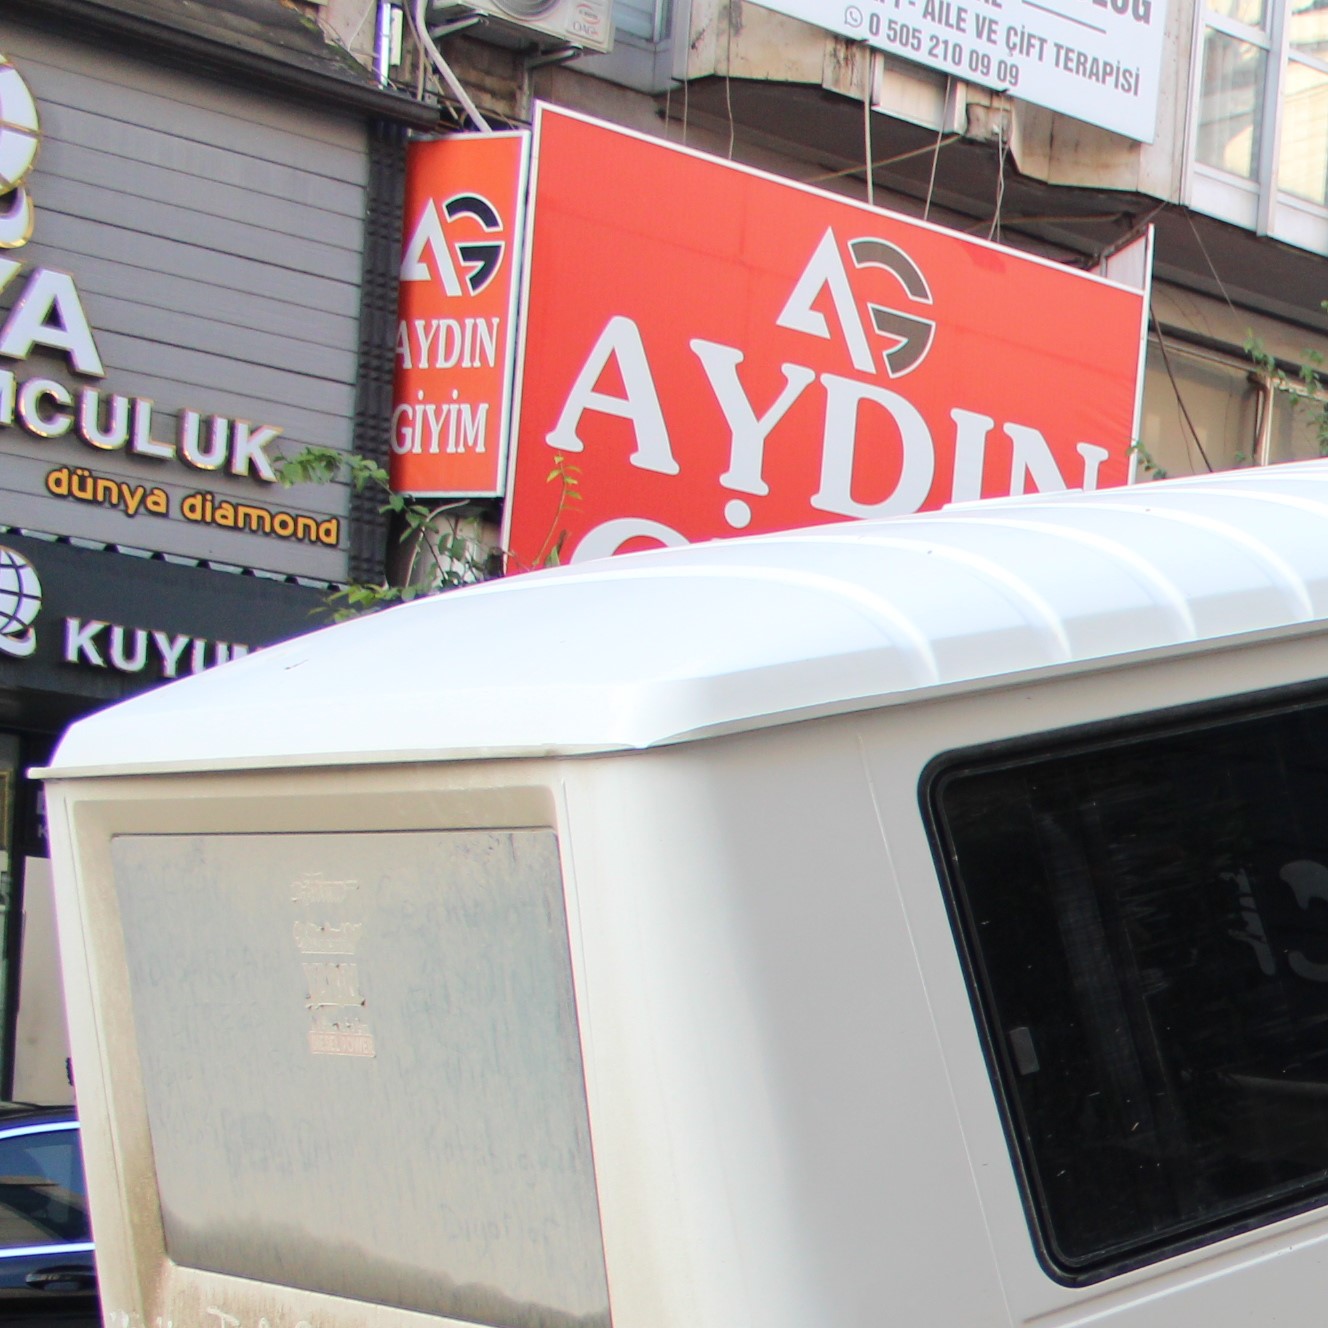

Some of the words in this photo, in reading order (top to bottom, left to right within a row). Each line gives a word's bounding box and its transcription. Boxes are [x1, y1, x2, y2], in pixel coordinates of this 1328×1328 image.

[868, 13, 881, 36] 0
[886, 20, 922, 51] 505
[928, 35, 963, 66] 210
[968, 49, 992, 77] 09
[996, 59, 1020, 87] 09
[974, 13, 998, 45] VE
[1005, 24, 1048, 63] ÇİFT
[1053, 42, 1140, 96] TERAPİSİ
[395, 316, 500, 370] AYDIN
[390, 388, 489, 455] GİYİM
[544, 315, 1109, 520] AYDIN
[46, 466, 169, 517] dünya
[181, 491, 341, 546] diamond
[62, 616, 264, 679] KUYU
